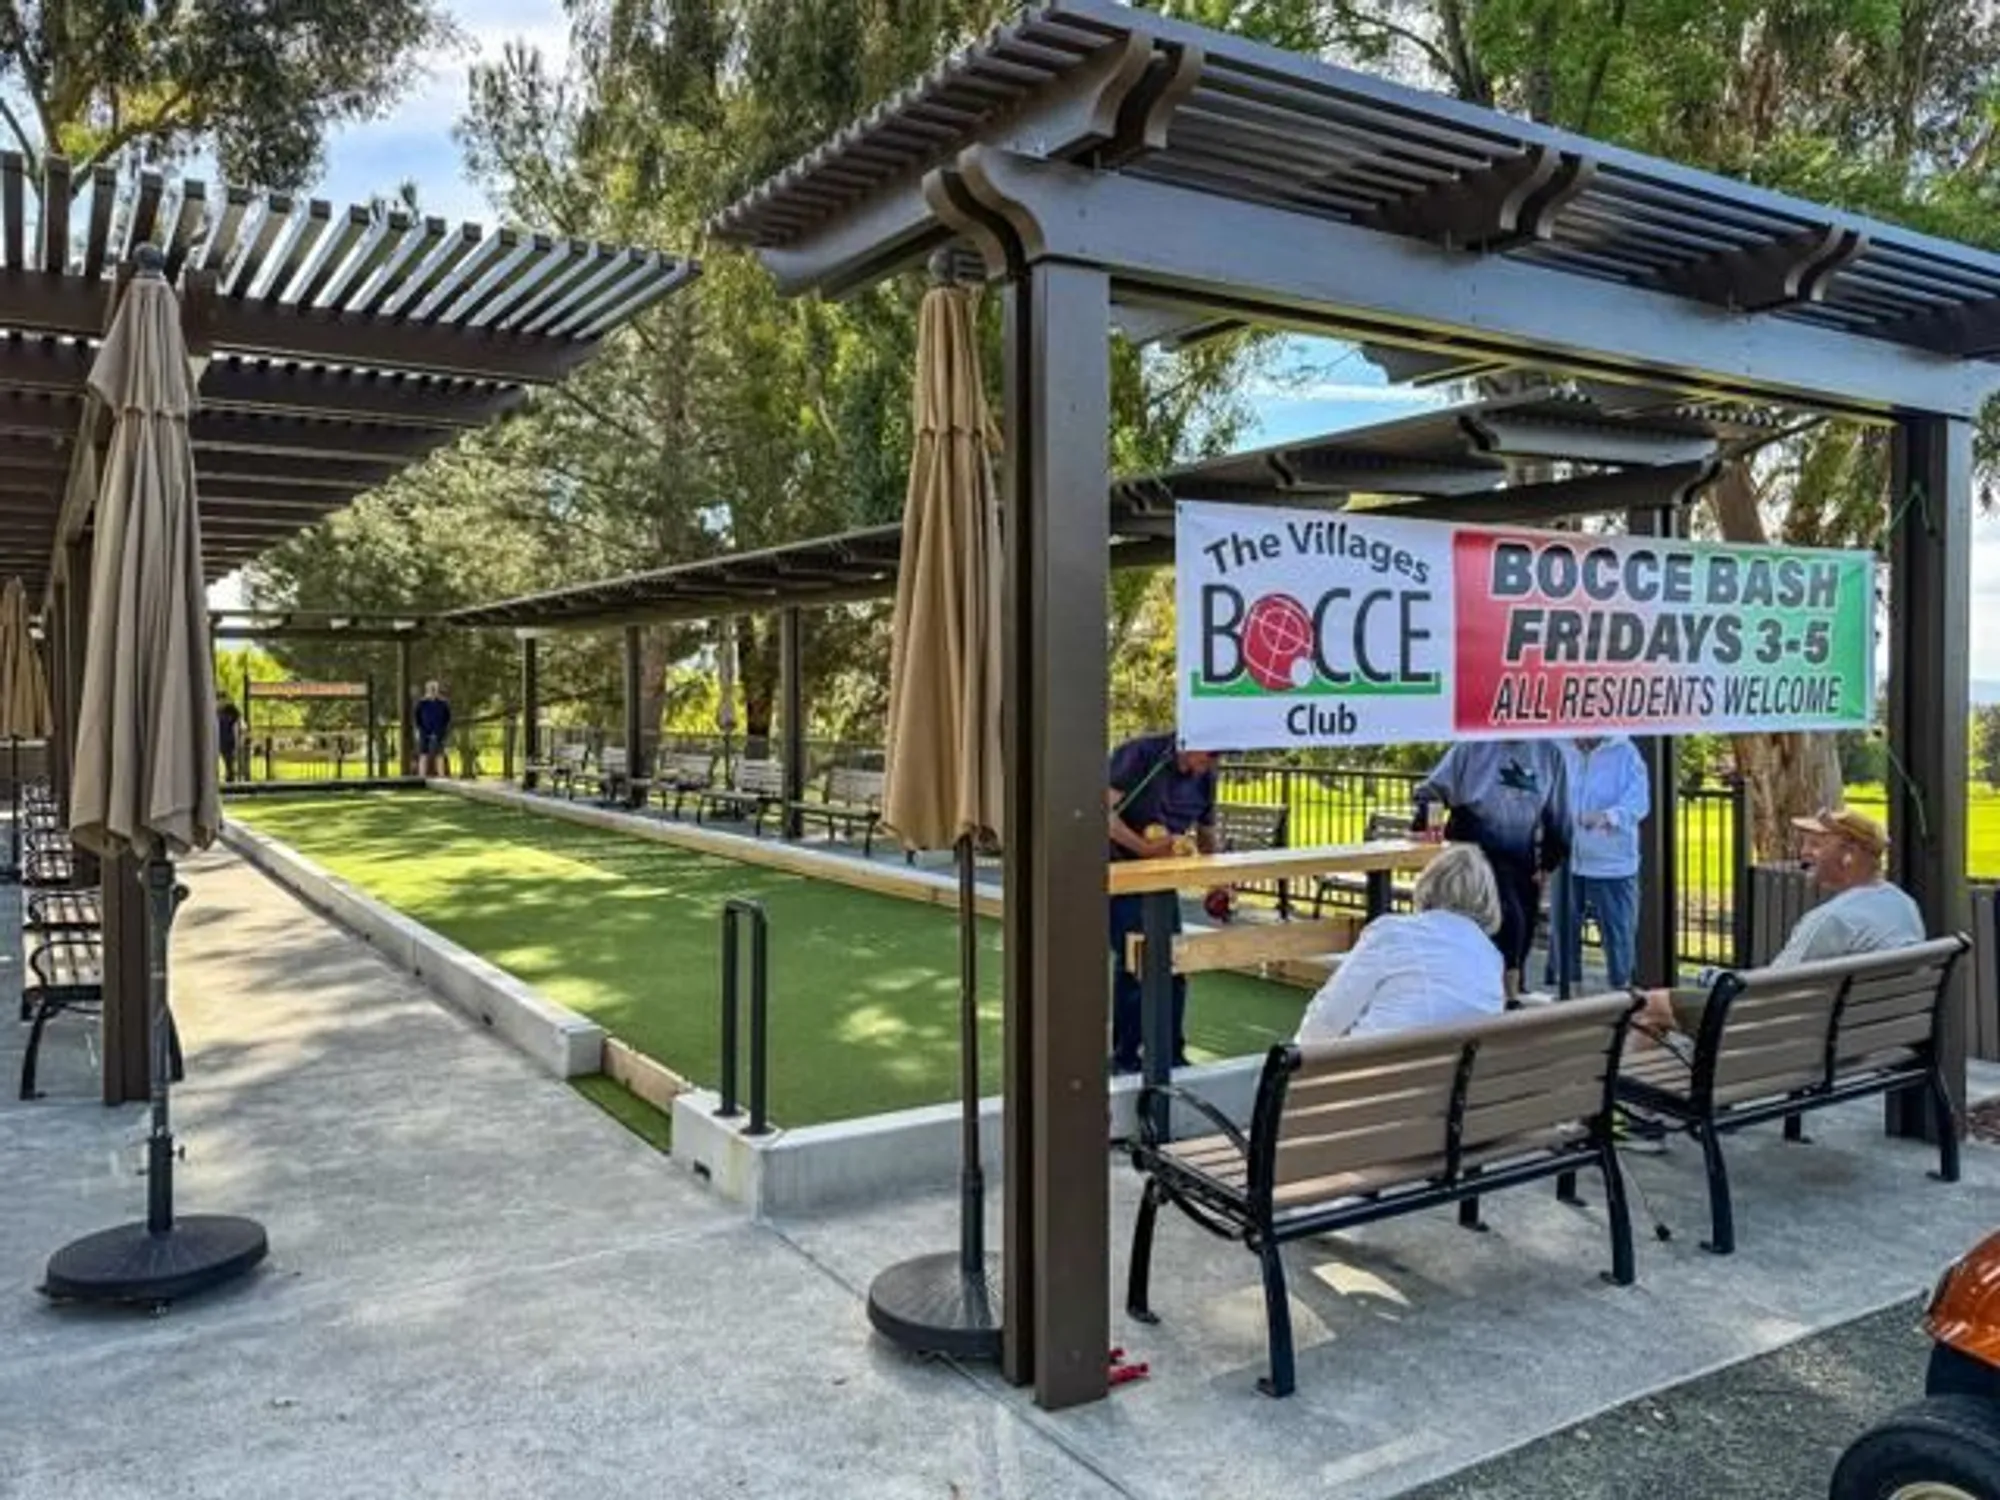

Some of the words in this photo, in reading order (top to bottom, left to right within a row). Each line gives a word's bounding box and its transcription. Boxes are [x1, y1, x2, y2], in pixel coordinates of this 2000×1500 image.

[1204, 532, 1280, 574] The
[1287, 521, 1431, 585] Villages
[1494, 543, 1693, 601] BOCCE
[1706, 556, 1839, 608] BASH
[1506, 609, 1743, 663] FRIDAYS
[1756, 618, 1831, 664] 3-5
[1286, 703, 1357, 735] Club
[1495, 677, 1549, 719] ALL
[1560, 676, 1715, 718] RESIDENTS
[1723, 675, 1842, 716] WELCOME
